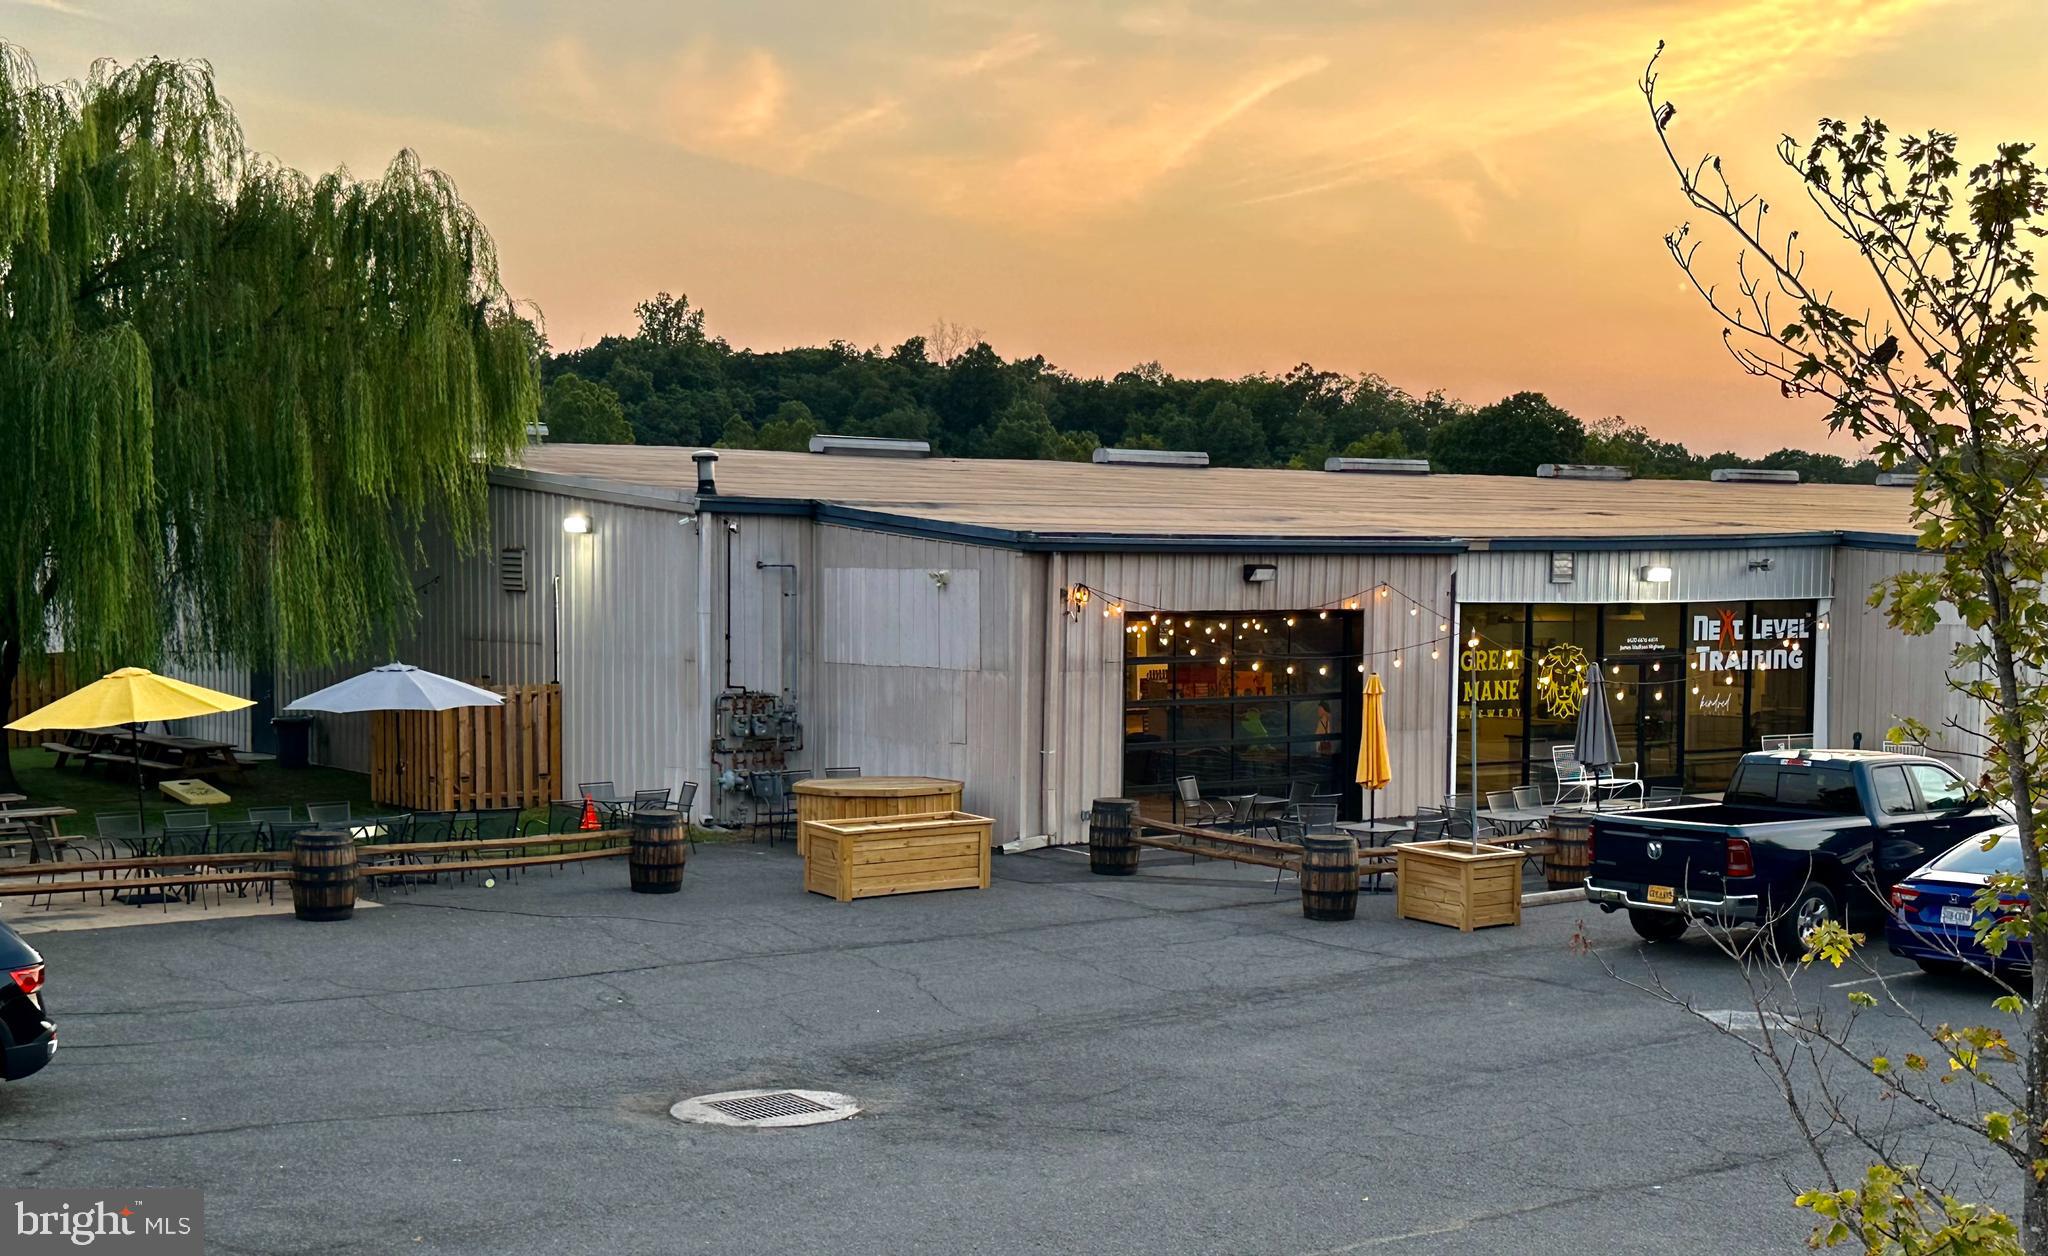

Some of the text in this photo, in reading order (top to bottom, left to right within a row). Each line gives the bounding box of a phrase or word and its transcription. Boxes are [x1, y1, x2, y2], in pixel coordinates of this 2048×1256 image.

[1752, 614, 1809, 640] LEVEL
[1461, 649, 1523, 671] GREAT
[1696, 646, 1804, 671] TRAINING
[1463, 680, 1520, 702] MANE
